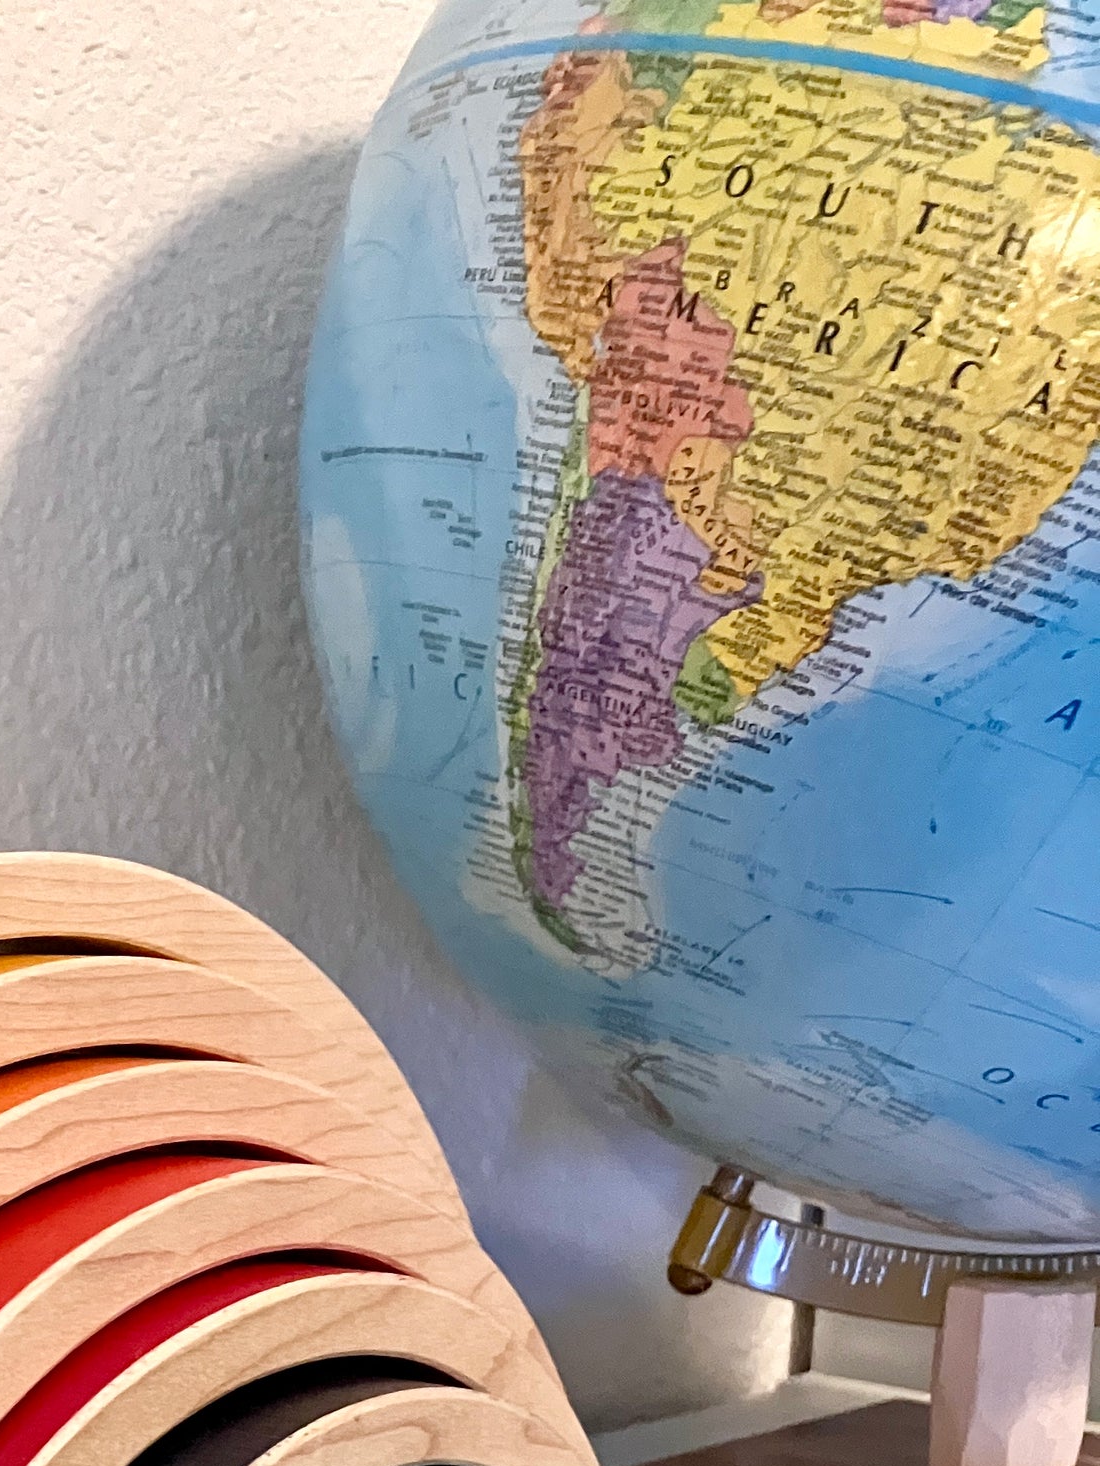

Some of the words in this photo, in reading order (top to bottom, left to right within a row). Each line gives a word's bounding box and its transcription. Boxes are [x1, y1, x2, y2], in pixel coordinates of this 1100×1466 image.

[654, 154, 1036, 261] SOUTH
[463, 267, 497, 282] PERU
[594, 277, 1051, 415] AMERICA
[621, 390, 715, 423] BOLIVIA
[505, 540, 546, 560] CHILE
